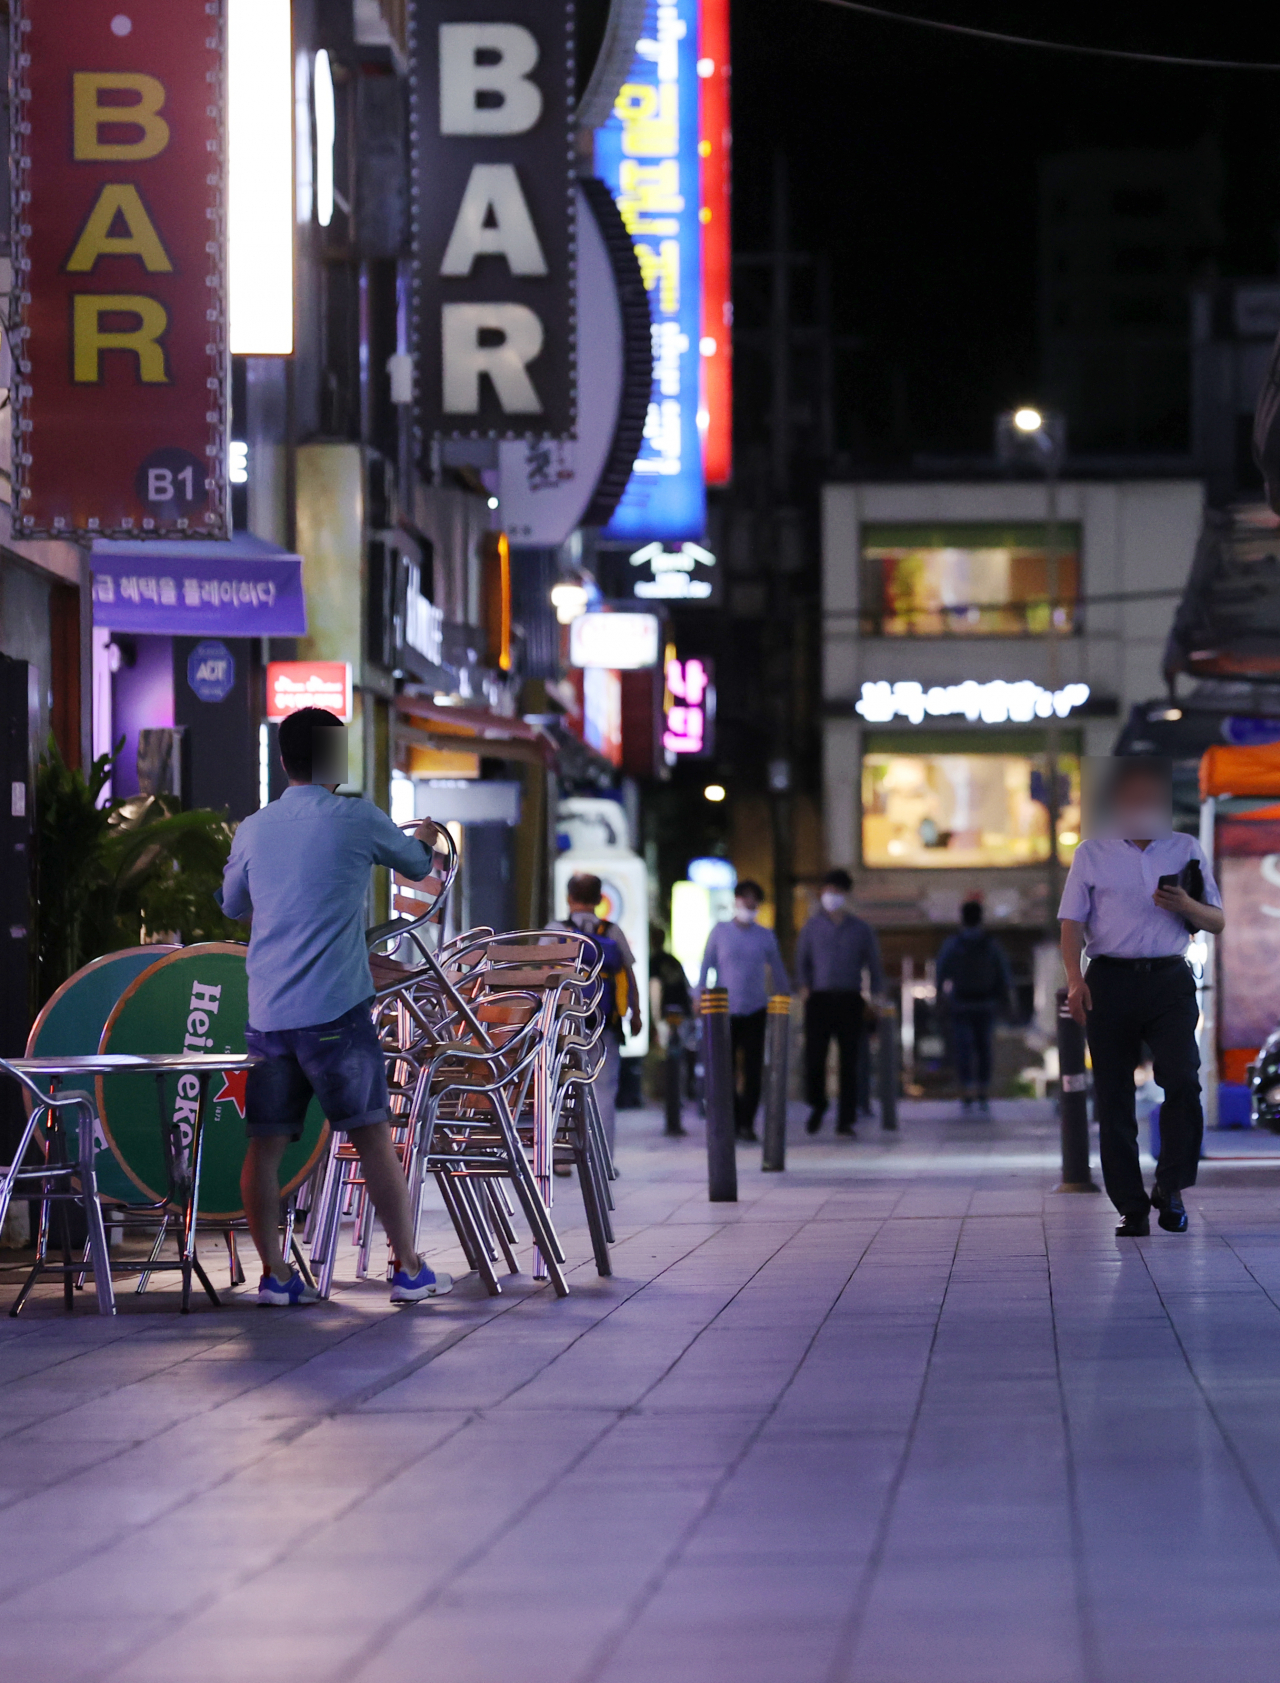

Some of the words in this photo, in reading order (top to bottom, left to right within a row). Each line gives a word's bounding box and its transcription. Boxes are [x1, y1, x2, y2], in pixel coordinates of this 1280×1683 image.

[65, 71, 174, 384] BAR
[438, 22, 549, 416] BAR
[147, 467, 194, 502] B1
[92, 574, 116, 603] 급
[182, 577, 276, 609] 플레이하다
[196, 659, 227, 682] ADT
[171, 980, 222, 1178] Heieke
